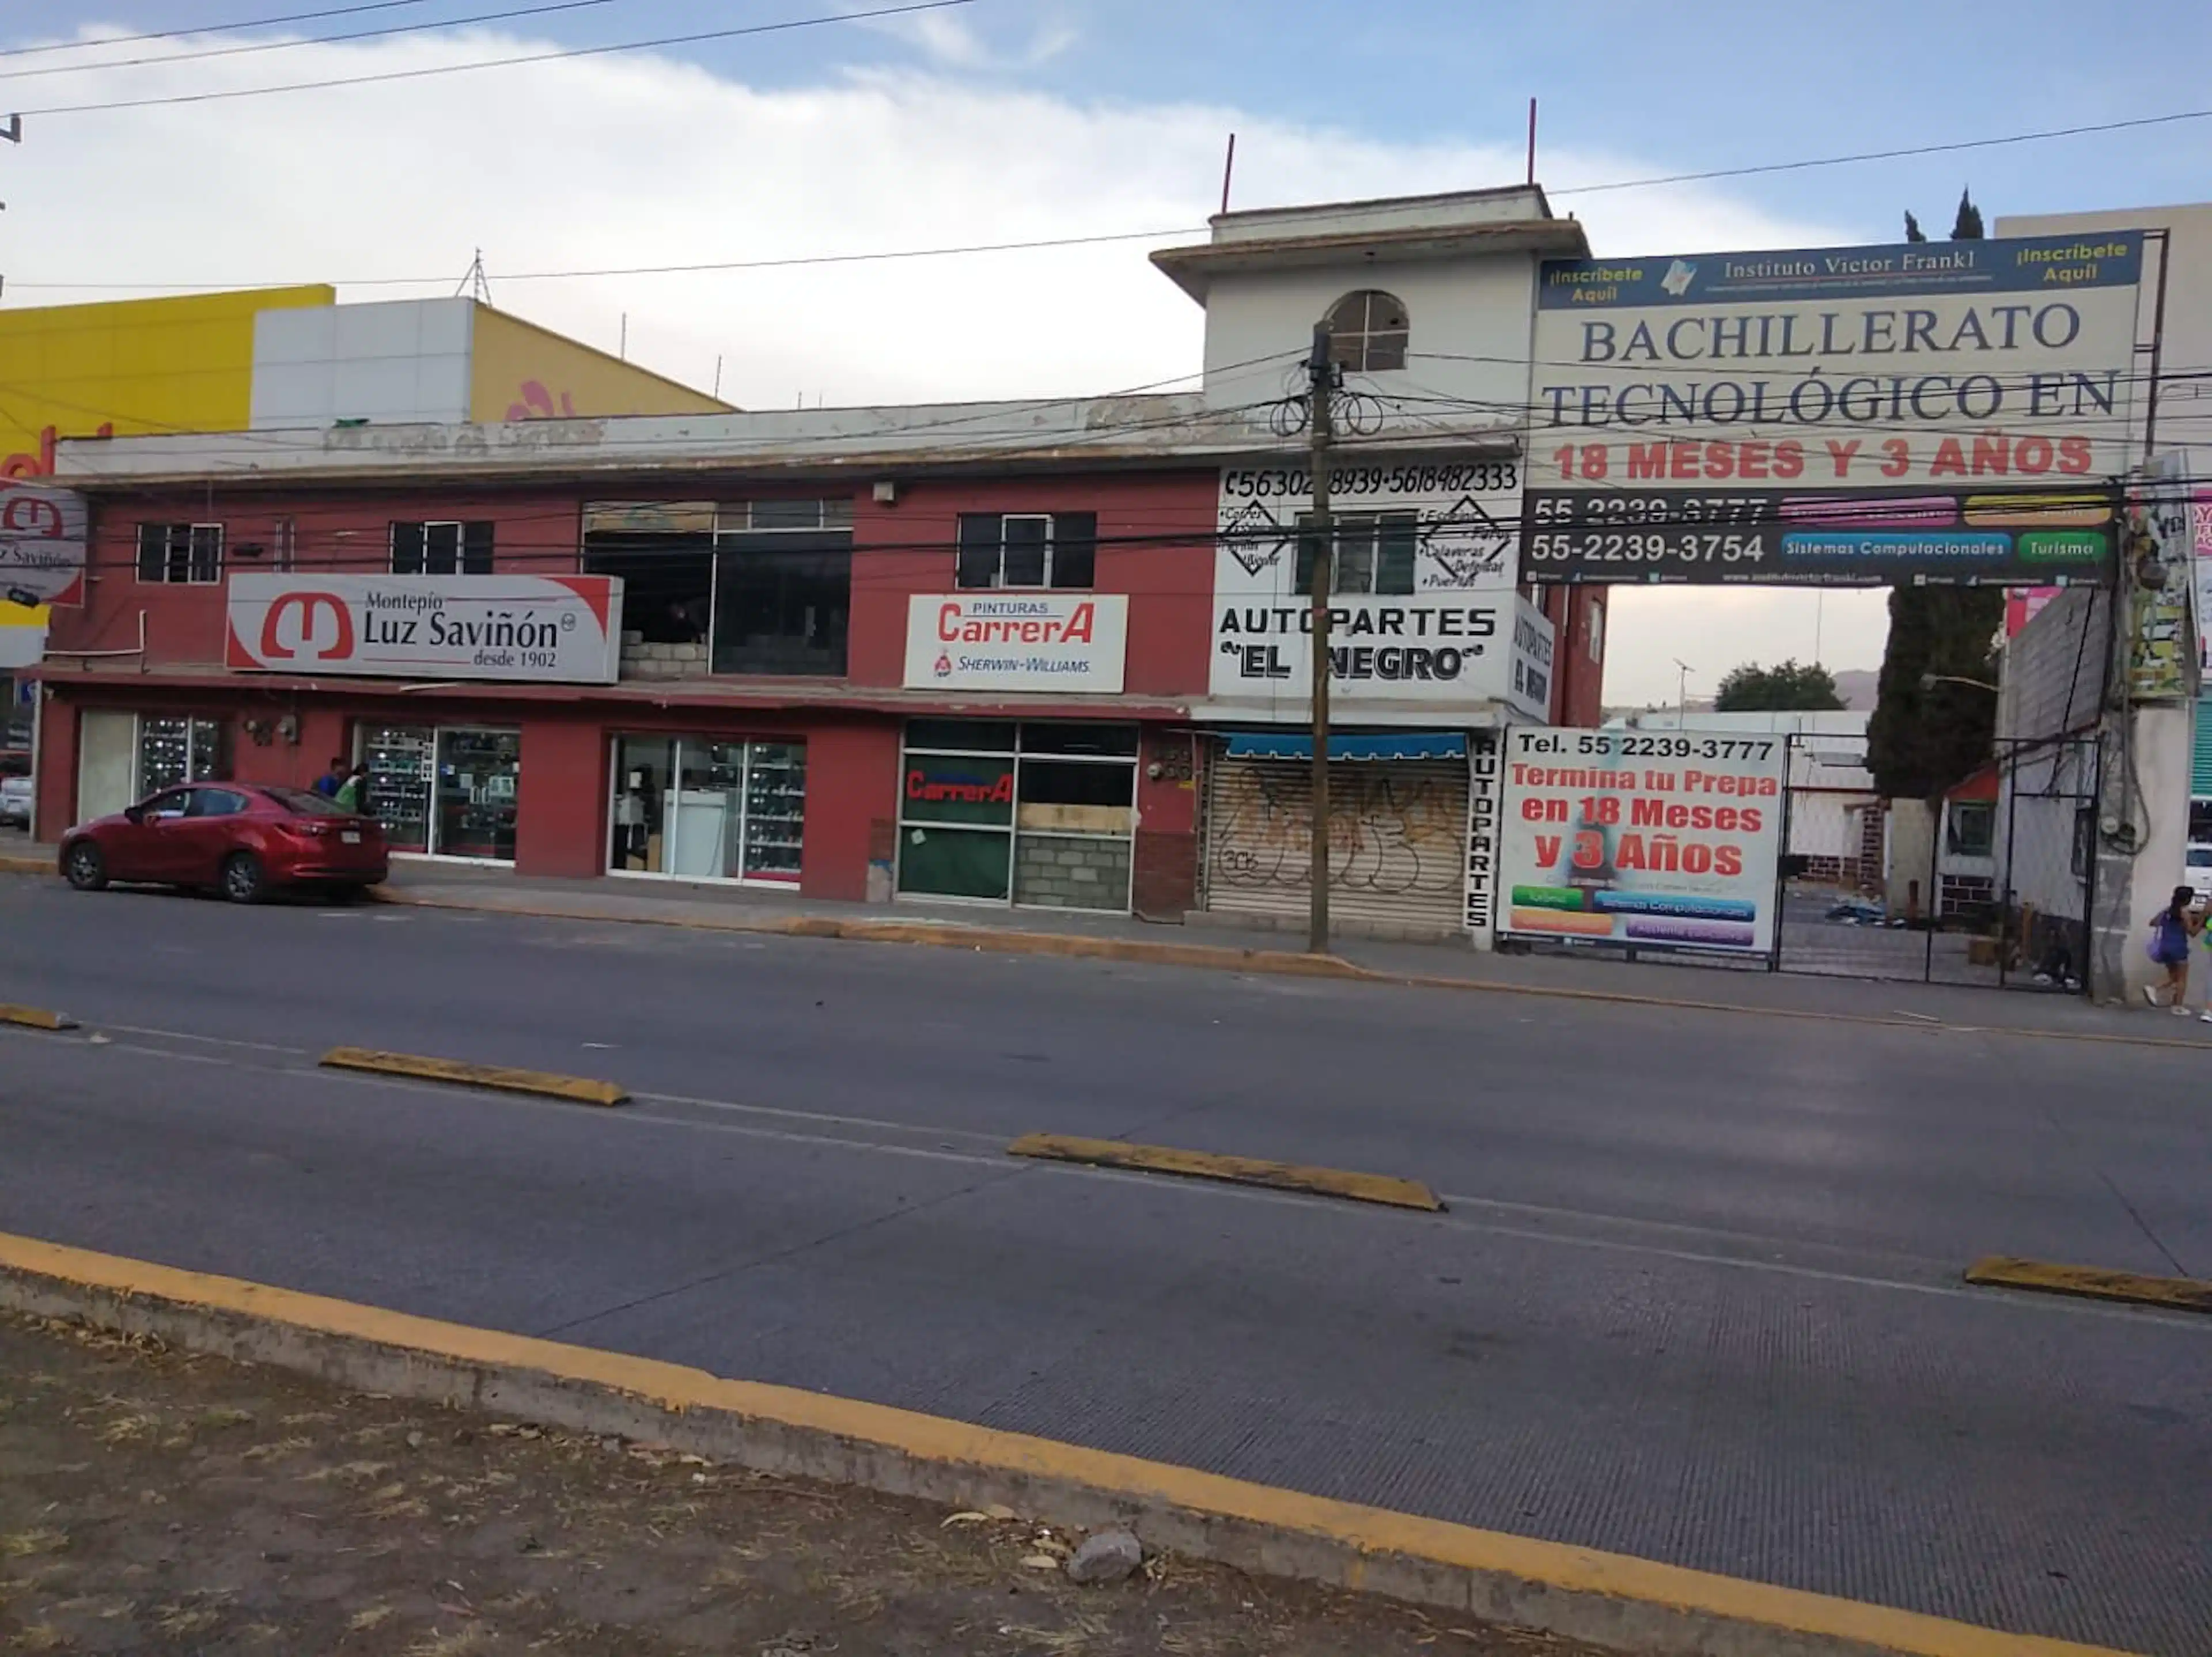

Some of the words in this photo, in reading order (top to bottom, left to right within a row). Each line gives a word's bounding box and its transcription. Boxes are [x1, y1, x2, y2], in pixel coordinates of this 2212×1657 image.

[1725, 261, 1815, 279] Instituto
[1903, 251, 1974, 271] Frankl
[1579, 303, 2081, 362] BACHILLERATO
[1541, 366, 2003, 427] TECNOLÓGICO
[2027, 370, 2121, 417] EN
[1554, 442, 1608, 480] 18
[1627, 440, 1804, 479] MESES
[1825, 439, 1862, 479] Y
[1881, 438, 1910, 478] 3
[1929, 427, 2092, 477] AÑOS
[1532, 534, 1764, 562] 55-2239-3754
[366, 590, 442, 616] Montepío
[972, 602, 1048, 614] PINTURAS
[364, 611, 418, 644] Luz
[430, 610, 557, 648] Saviñón
[938, 602, 1094, 643] CarrerA
[474, 649, 514, 666] desde
[521, 651, 556, 668] 1902
[1518, 734, 1566, 754] Tel.
[1578, 735, 1611, 754] 55
[1621, 738, 1774, 761] 2239-3777
[1512, 763, 1635, 790] Termina
[1645, 769, 1675, 791] tu
[1684, 770, 1777, 797] Prepa
[1522, 798, 1567, 822] en
[1581, 797, 1620, 825] 18
[1631, 798, 1762, 832] Meses
[1467, 739, 1496, 927] AUTOPARTES
[1573, 830, 1604, 869] 3
[1616, 833, 1743, 876] Años
